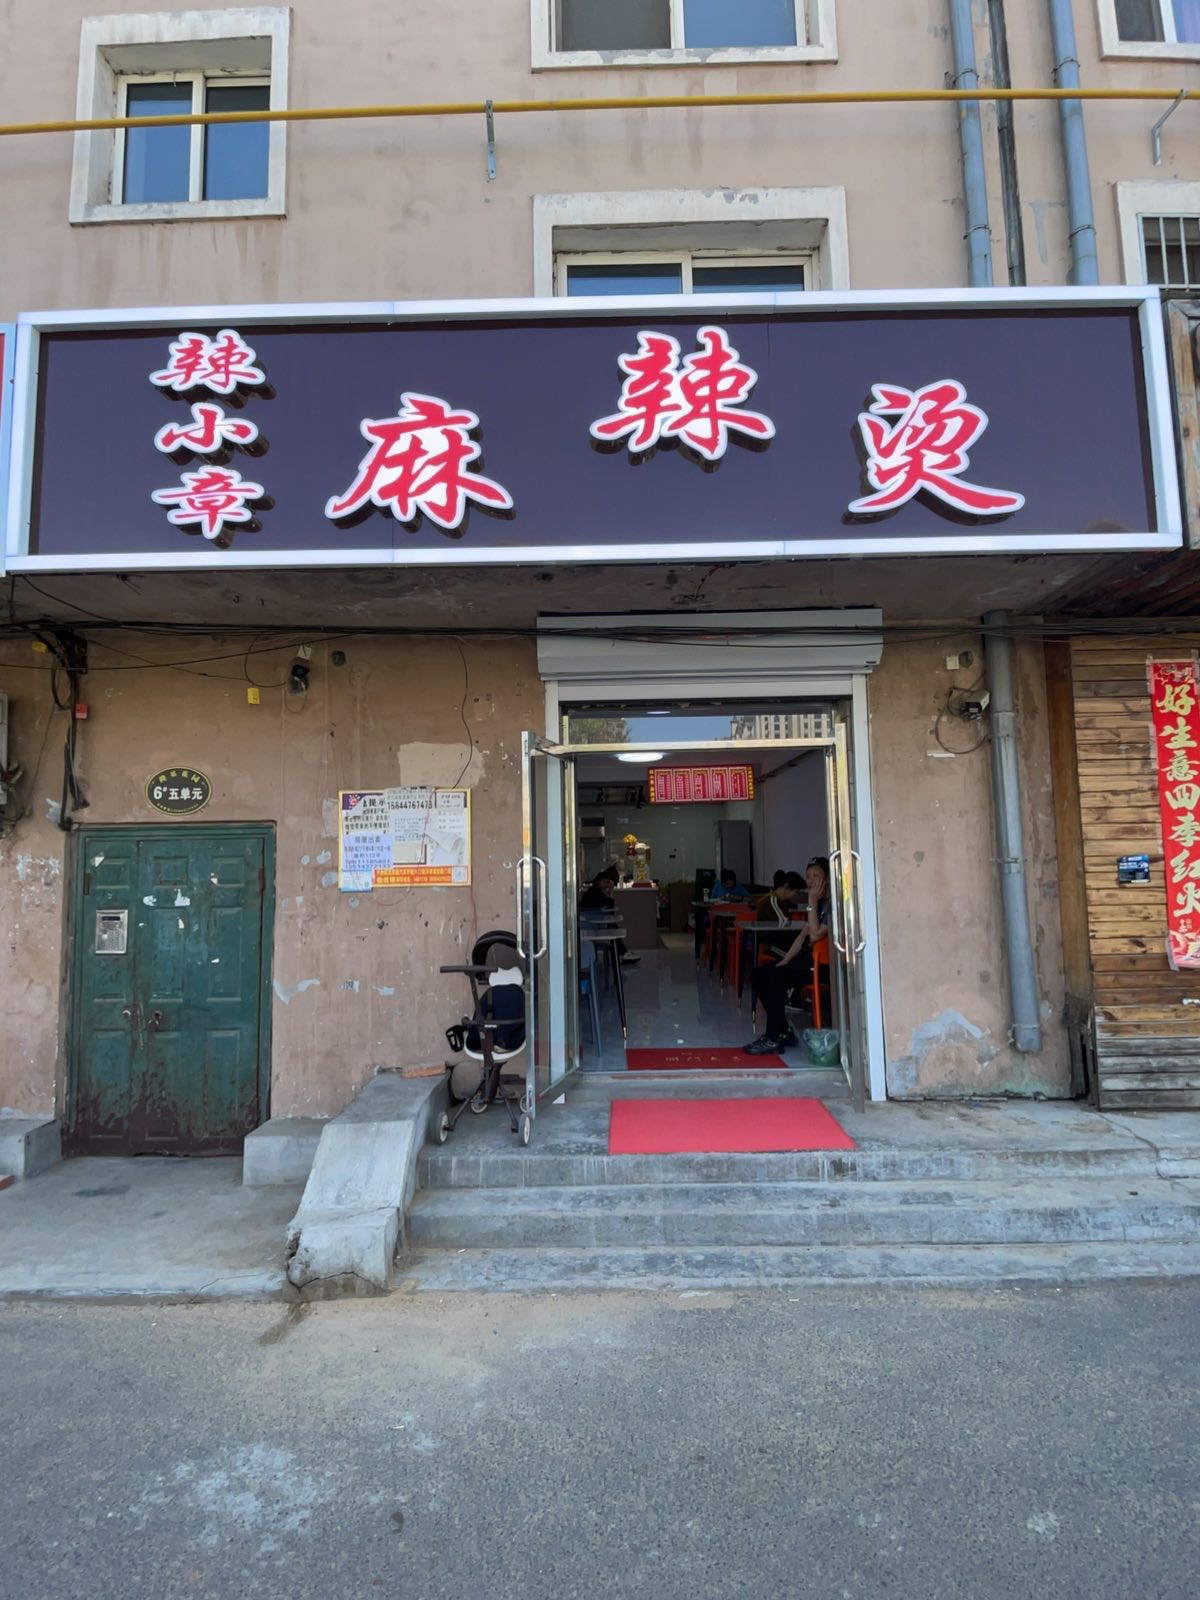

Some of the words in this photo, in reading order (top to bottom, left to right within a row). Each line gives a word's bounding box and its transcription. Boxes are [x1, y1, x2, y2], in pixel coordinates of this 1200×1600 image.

[150, 329, 265, 539] 辣小章
[325, 326, 1025, 531] 麻辣烫
[1156, 684, 1200, 917] 好生意四季红火
